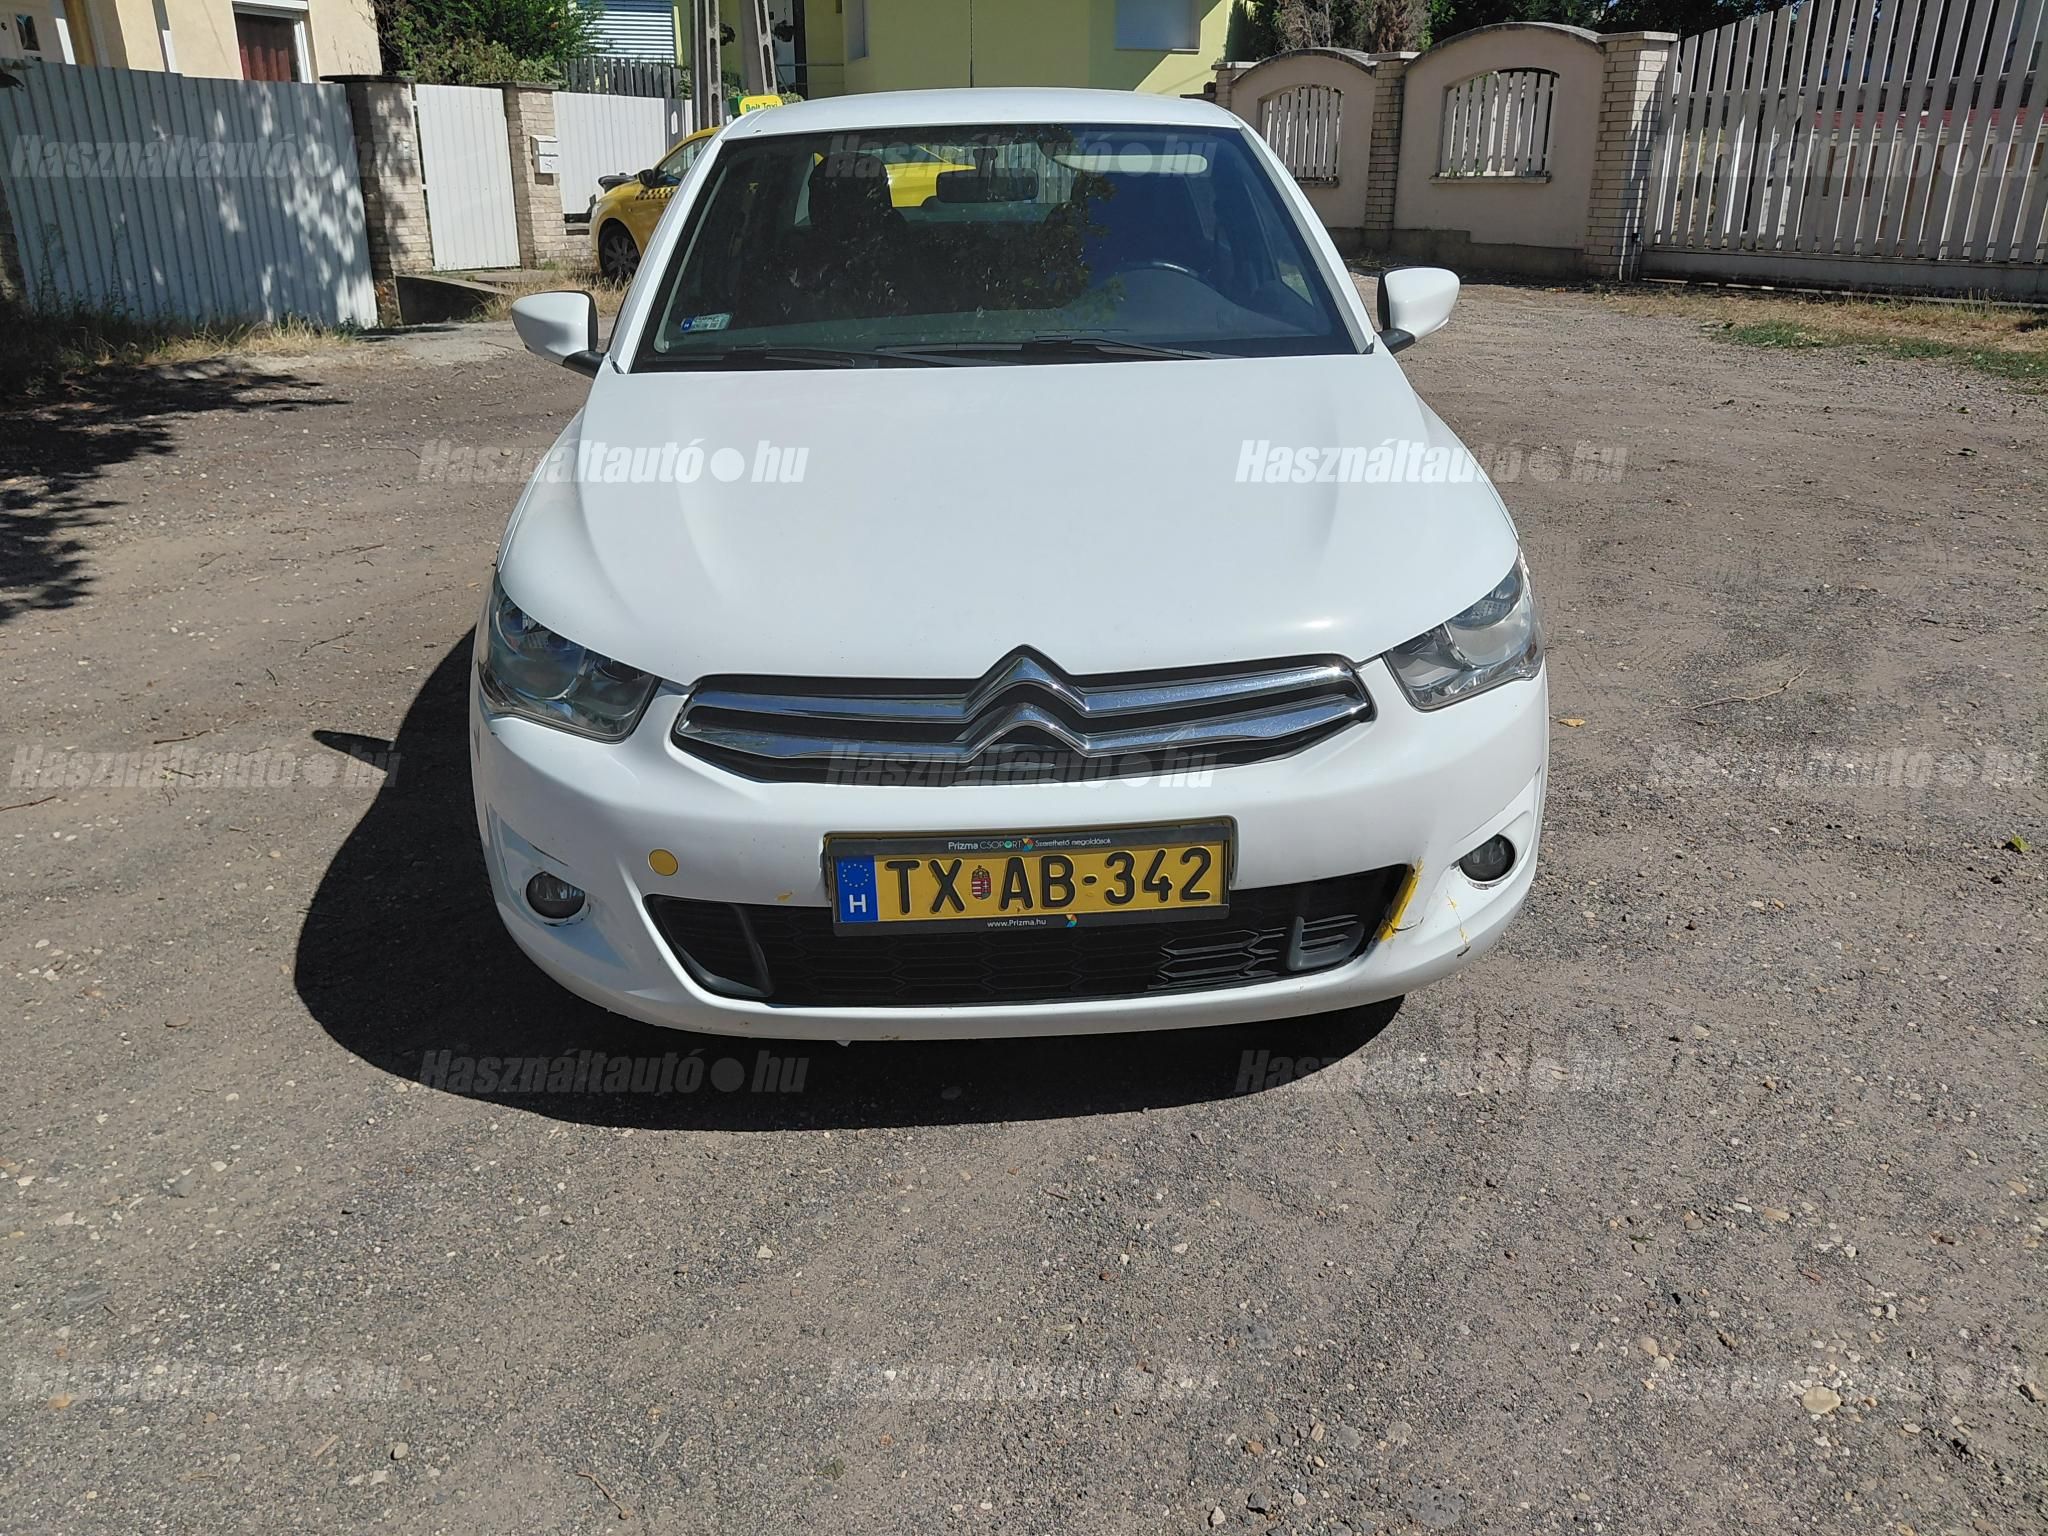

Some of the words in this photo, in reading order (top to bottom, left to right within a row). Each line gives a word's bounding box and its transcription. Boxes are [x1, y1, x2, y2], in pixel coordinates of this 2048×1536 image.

[948, 841, 979, 851] Prizma
[980, 840, 1022, 849] CSOPORT
[886, 857, 966, 914] TX
[999, 848, 1212, 910] AB-342
[848, 893, 868, 913] H
[986, 918, 1047, 928] www.Prizma.hu
